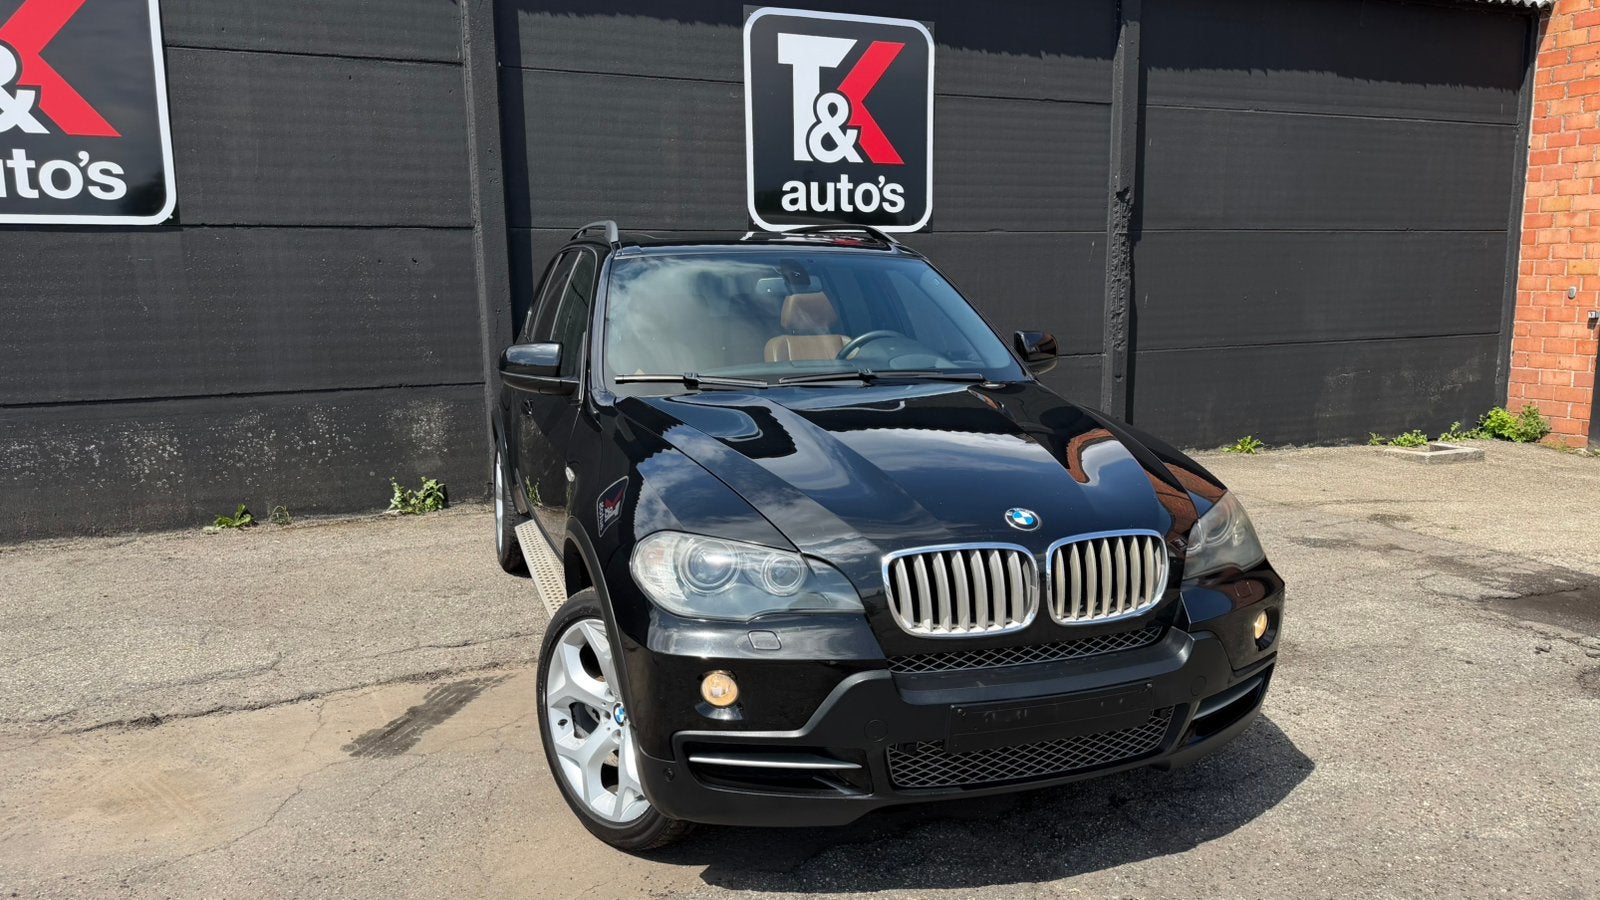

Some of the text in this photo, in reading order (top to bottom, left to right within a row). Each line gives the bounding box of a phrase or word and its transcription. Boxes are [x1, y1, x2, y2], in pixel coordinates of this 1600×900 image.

[0, 0, 122, 138] &K
[777, 32, 906, 165] T&K
[0, 149, 127, 200] to's
[781, 174, 905, 213] auto's
